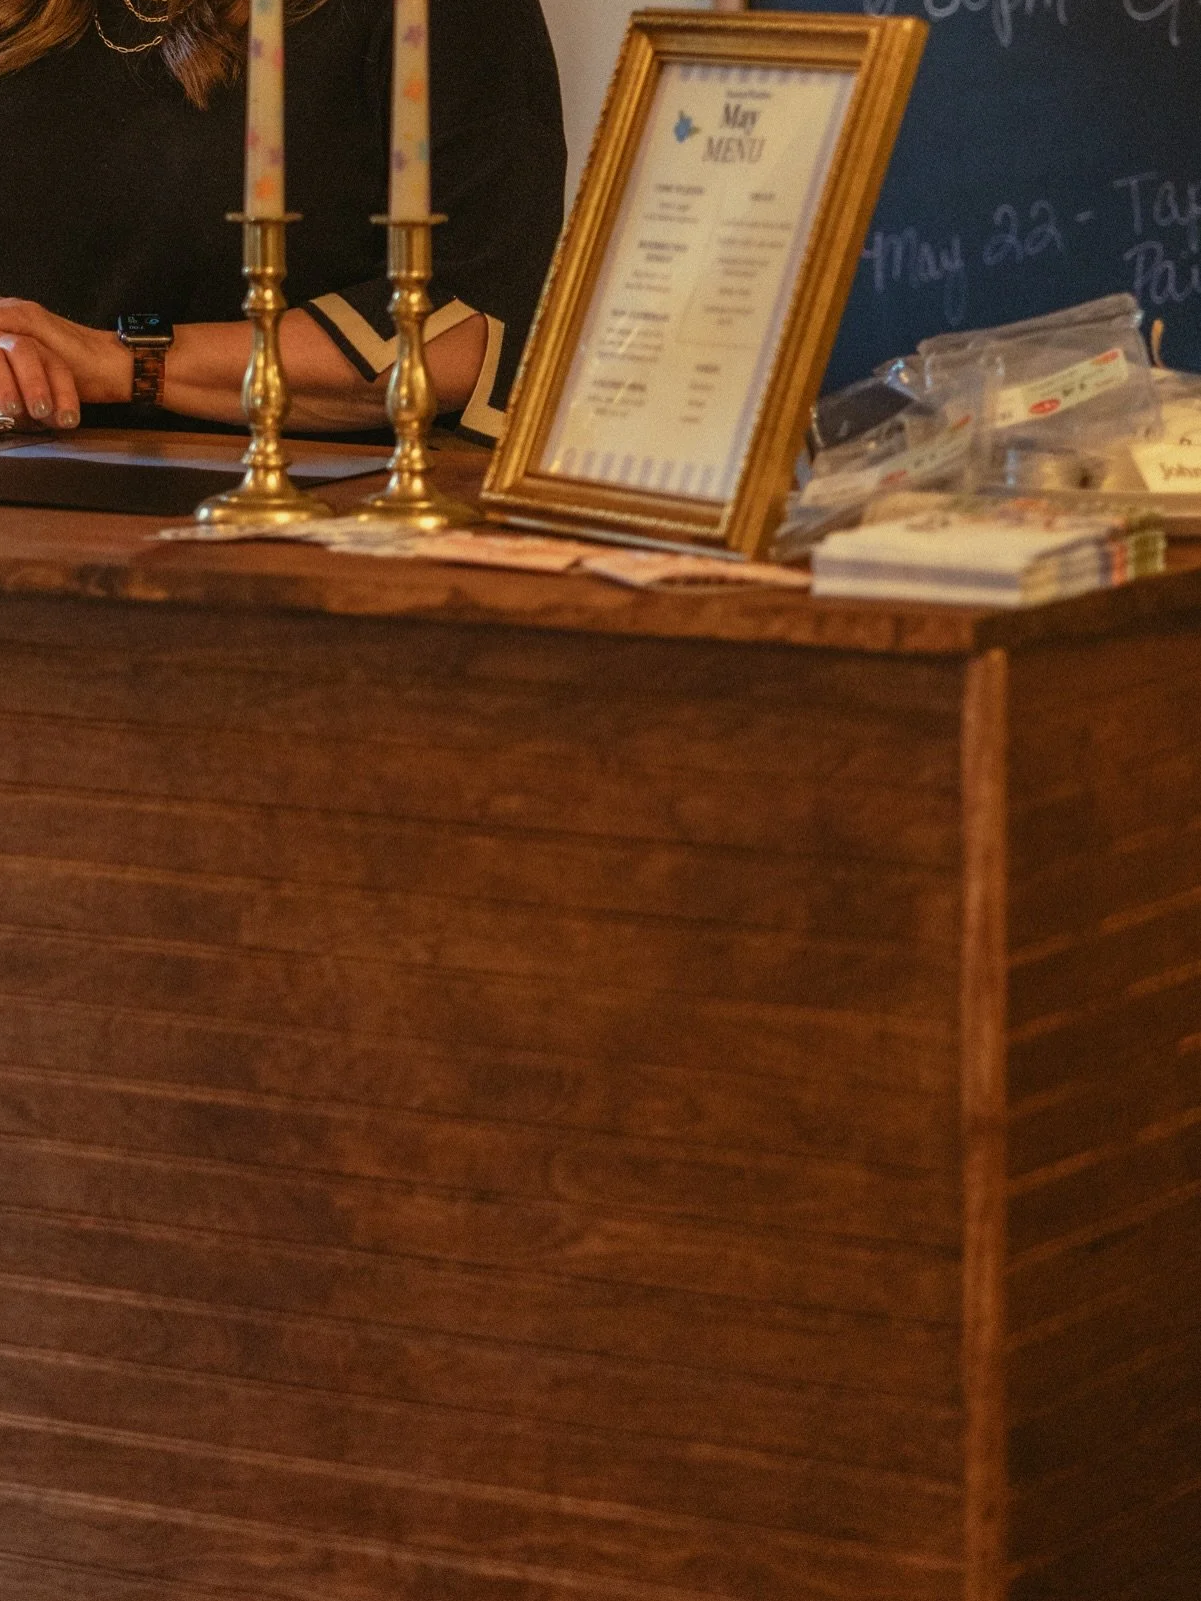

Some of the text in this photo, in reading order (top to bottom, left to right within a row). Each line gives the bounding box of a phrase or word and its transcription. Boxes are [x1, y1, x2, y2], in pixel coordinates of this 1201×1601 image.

[719, 102, 763, 136] May
[702, 136, 767, 164] MENU
[861, 227, 970, 326] May
